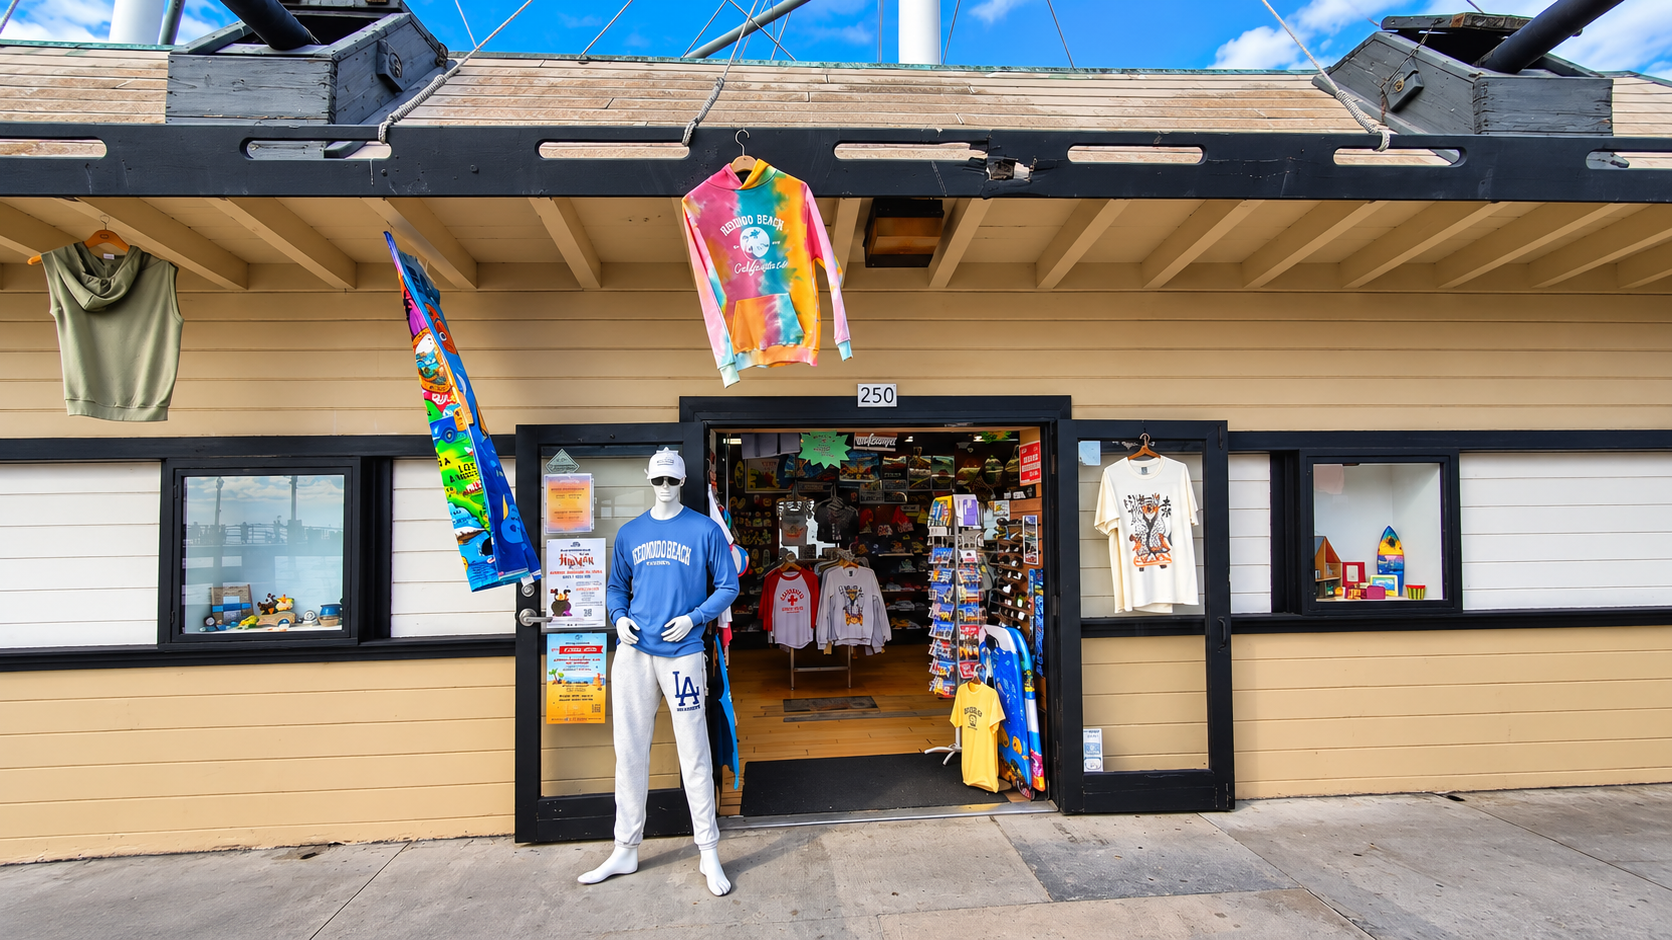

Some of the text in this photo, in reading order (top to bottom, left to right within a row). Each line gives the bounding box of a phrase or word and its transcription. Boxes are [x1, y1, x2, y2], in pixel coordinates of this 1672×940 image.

[861, 387, 894, 403] 250
[667, 541, 692, 566] BEACH
[672, 671, 700, 706] LA
